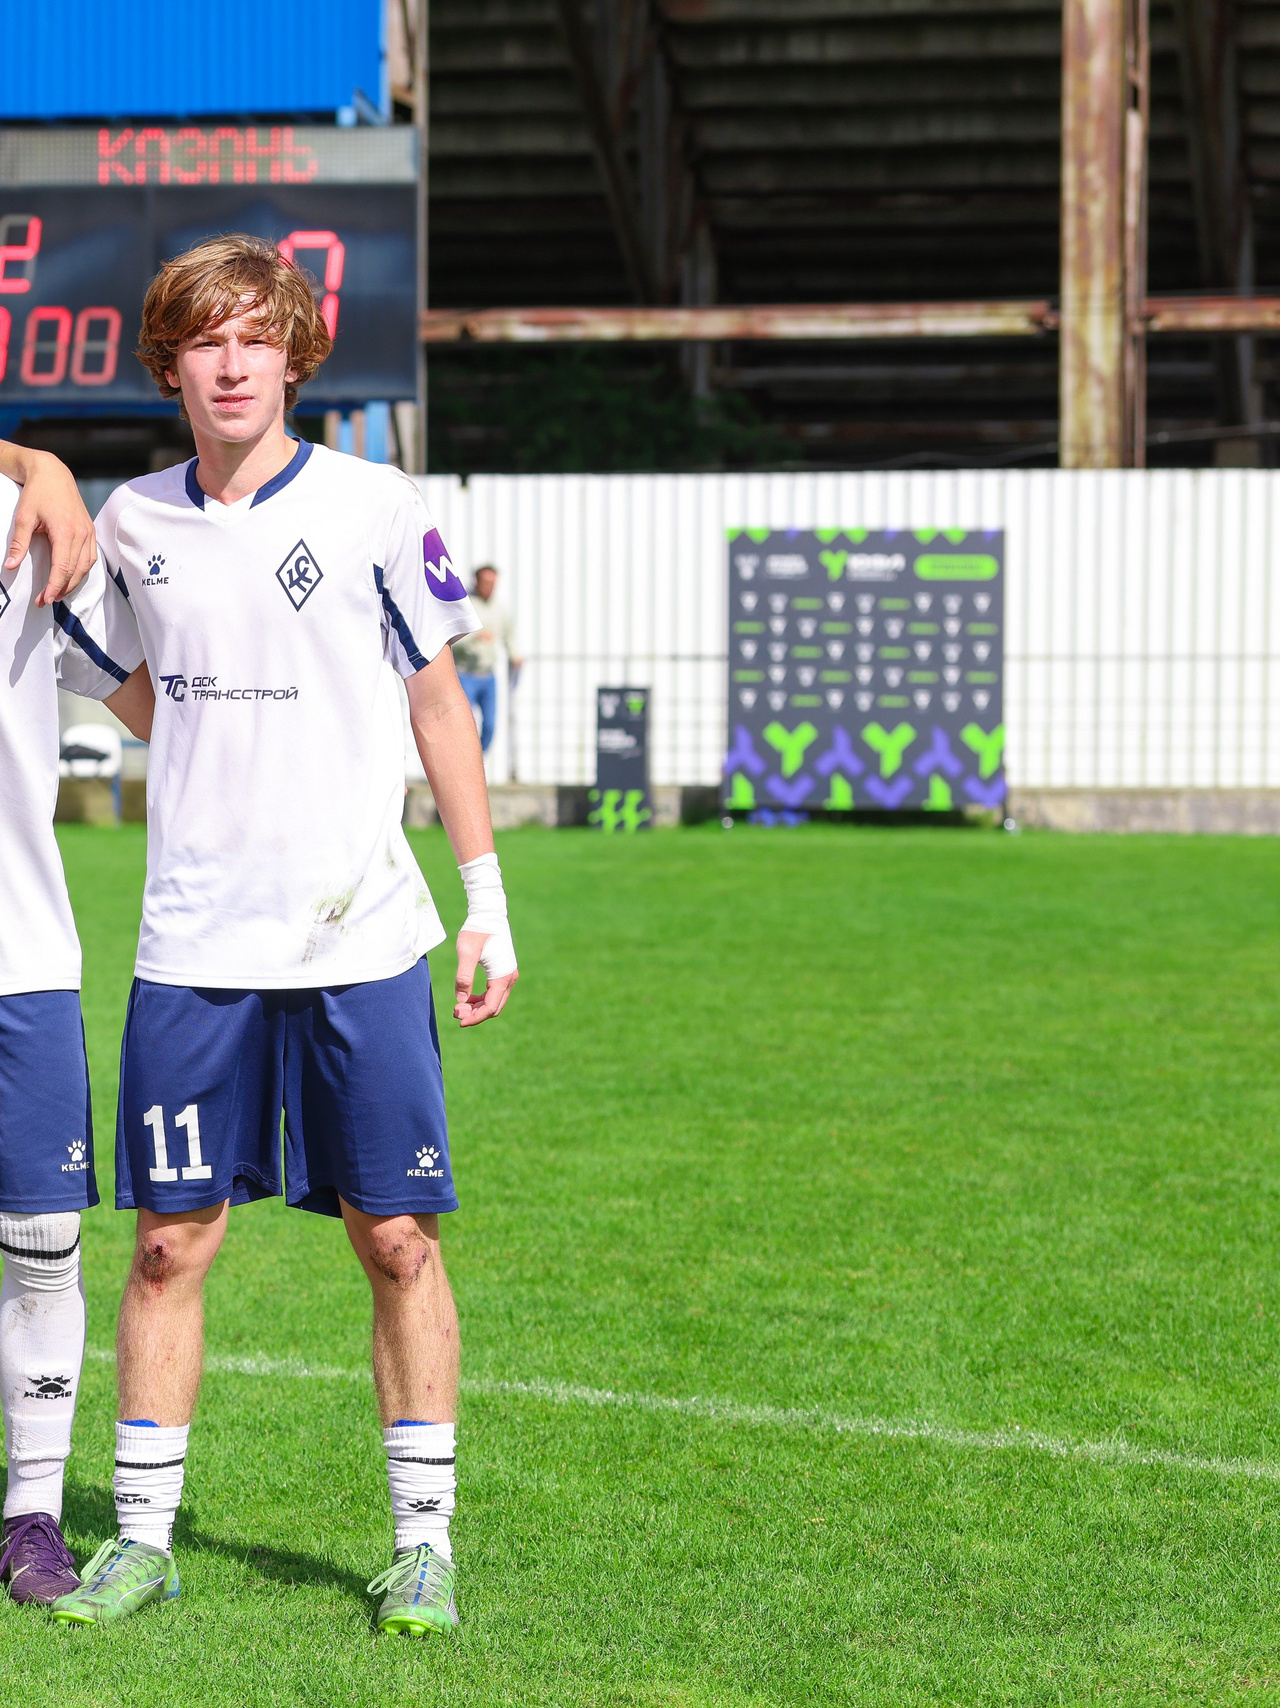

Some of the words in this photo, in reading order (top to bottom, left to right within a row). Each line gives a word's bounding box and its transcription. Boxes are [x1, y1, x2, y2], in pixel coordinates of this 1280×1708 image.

[141, 577, 170, 586] KELME
[191, 676, 218, 688] ДСК
[191, 686, 299, 701] ТРАНССТРОЙ
[142, 1104, 213, 1182] 11
[61, 1161, 90, 1172] KELME
[406, 1168, 444, 1178] KELME
[23, 1390, 72, 1400] KELME
